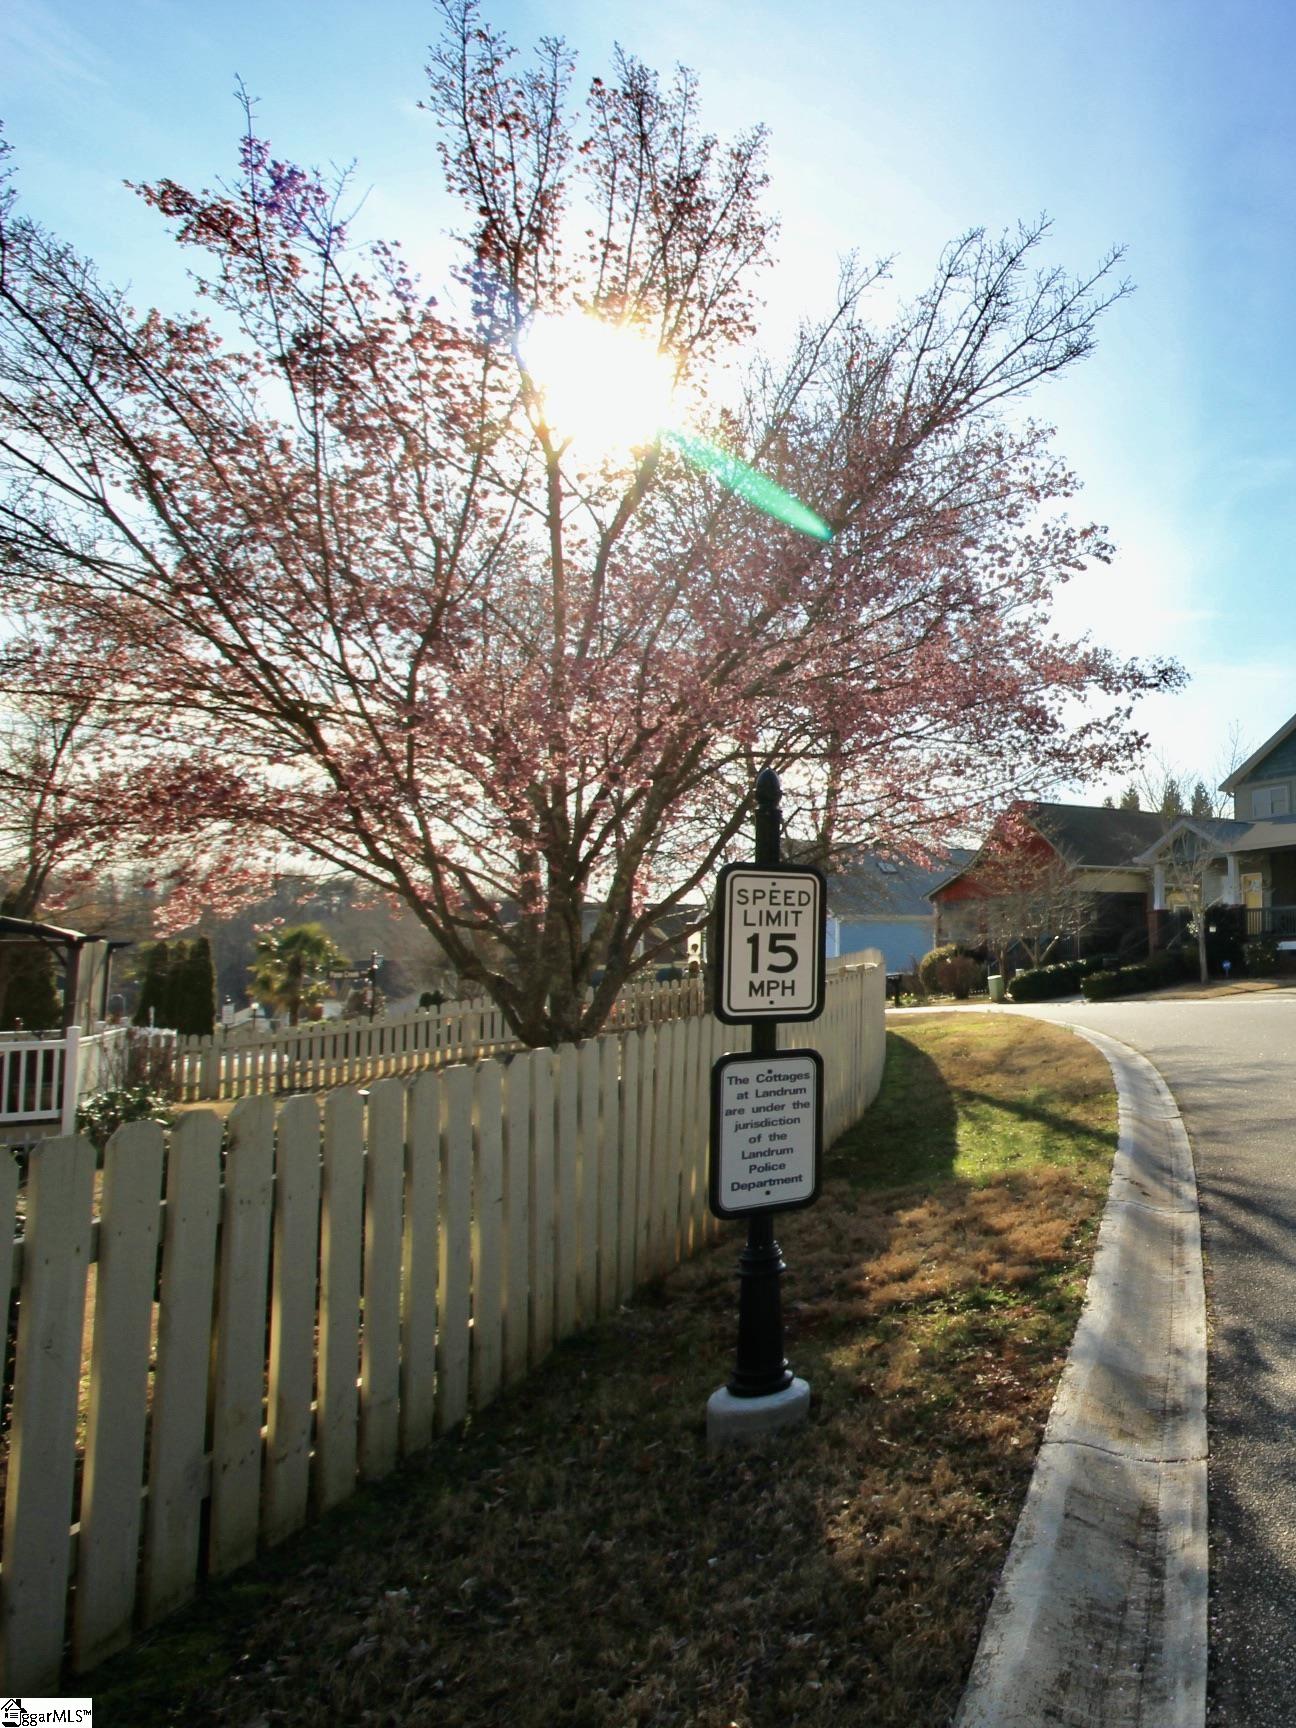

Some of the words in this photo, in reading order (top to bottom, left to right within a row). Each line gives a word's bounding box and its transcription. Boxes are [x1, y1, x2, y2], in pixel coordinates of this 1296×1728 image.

[736, 889, 811, 907] SPEED
[743, 910, 803, 927] LIMIT
[746, 932, 799, 974] 15
[748, 980, 795, 997] MPH
[726, 1076, 750, 1085] The
[756, 1071, 810, 1084] Cottages
[736, 1091, 749, 1100] at
[755, 1086, 807, 1099] Landrum
[724, 1107, 745, 1116] are
[751, 1103, 786, 1114] under
[792, 1100, 810, 1109] the
[734, 1116, 801, 1133] jurisdiction
[748, 1134, 762, 1144] of
[768, 1132, 788, 1142] the
[741, 1146, 794, 1160] Landrum
[749, 1161, 786, 1174] Police
[730, 1174, 803, 1192] Department
